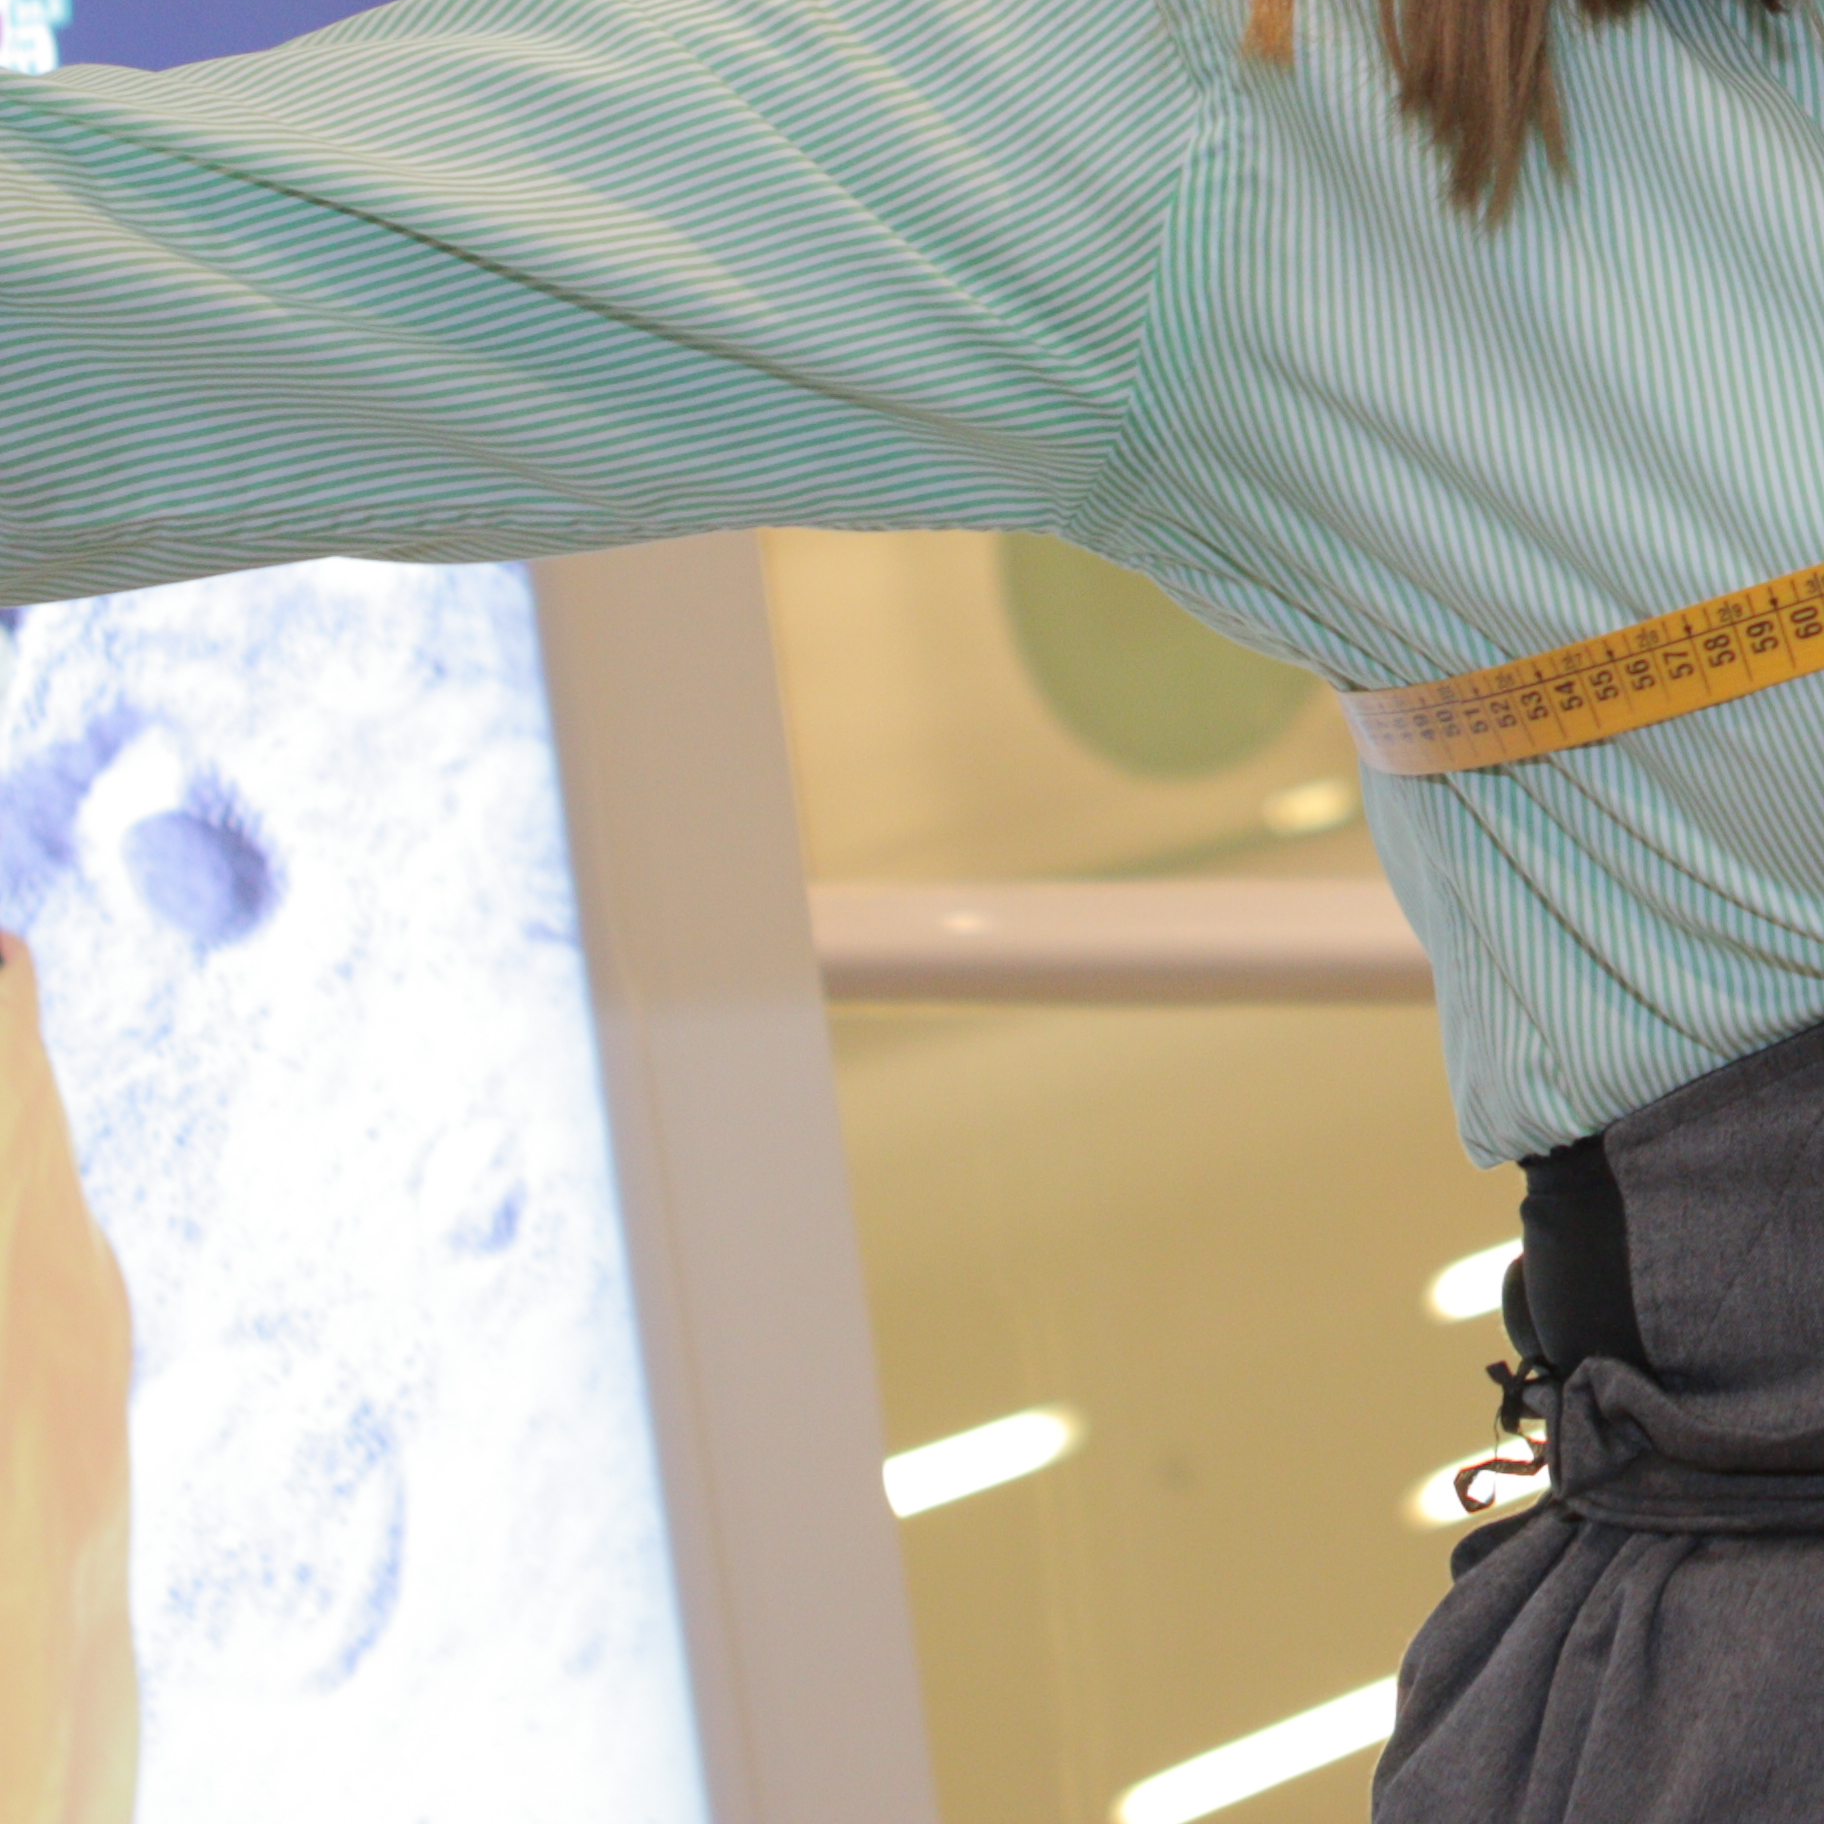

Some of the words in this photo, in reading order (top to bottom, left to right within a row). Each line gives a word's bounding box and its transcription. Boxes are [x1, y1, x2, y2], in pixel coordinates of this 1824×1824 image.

[1746, 621, 1779, 654] 59
[1790, 606, 1823, 639] 60
[1664, 651, 1694, 680] 57
[1704, 634, 1736, 668] 58
[1590, 670, 1619, 700] 55
[1626, 659, 1655, 691] 56
[1522, 691, 1548, 720] 53
[1555, 681, 1584, 711] 54
[1490, 702, 1516, 727] 52
